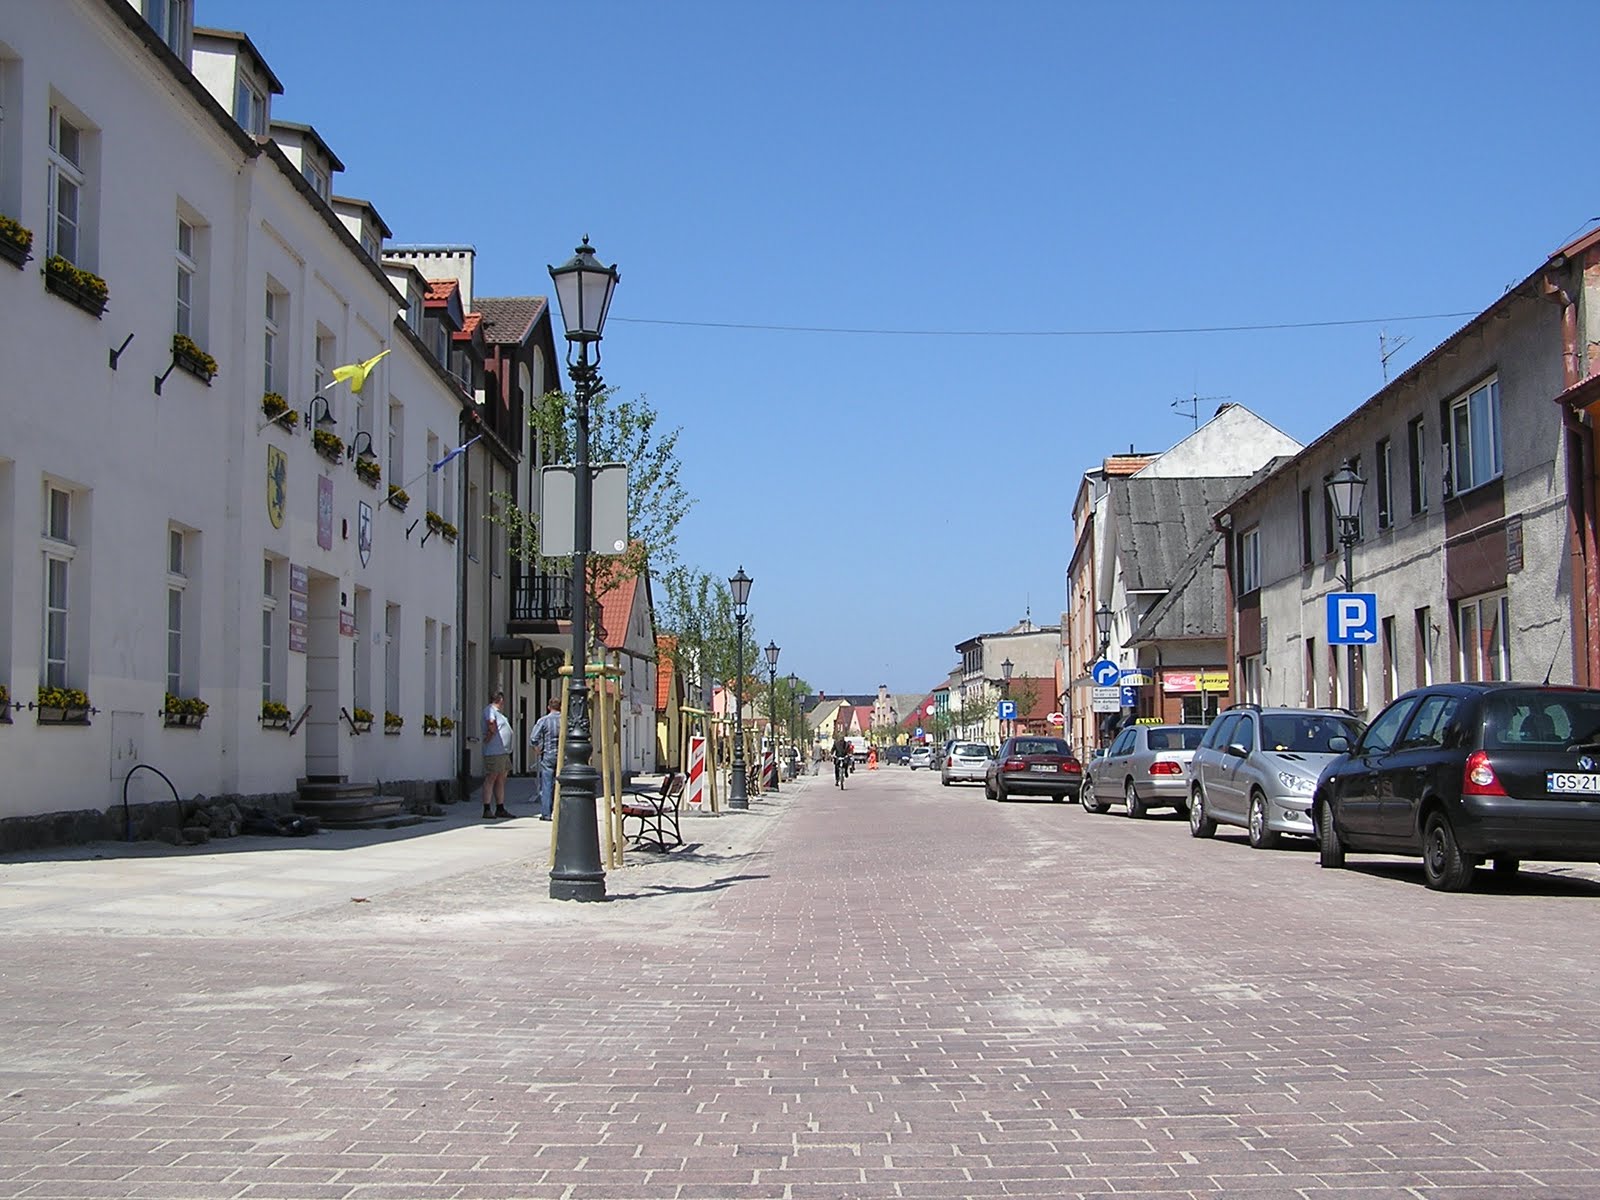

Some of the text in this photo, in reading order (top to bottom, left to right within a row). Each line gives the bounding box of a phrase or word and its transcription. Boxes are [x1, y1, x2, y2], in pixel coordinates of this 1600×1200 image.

[1337, 598, 1367, 639] P
[1002, 702, 1014, 718] P
[1556, 774, 1577, 790] GS
